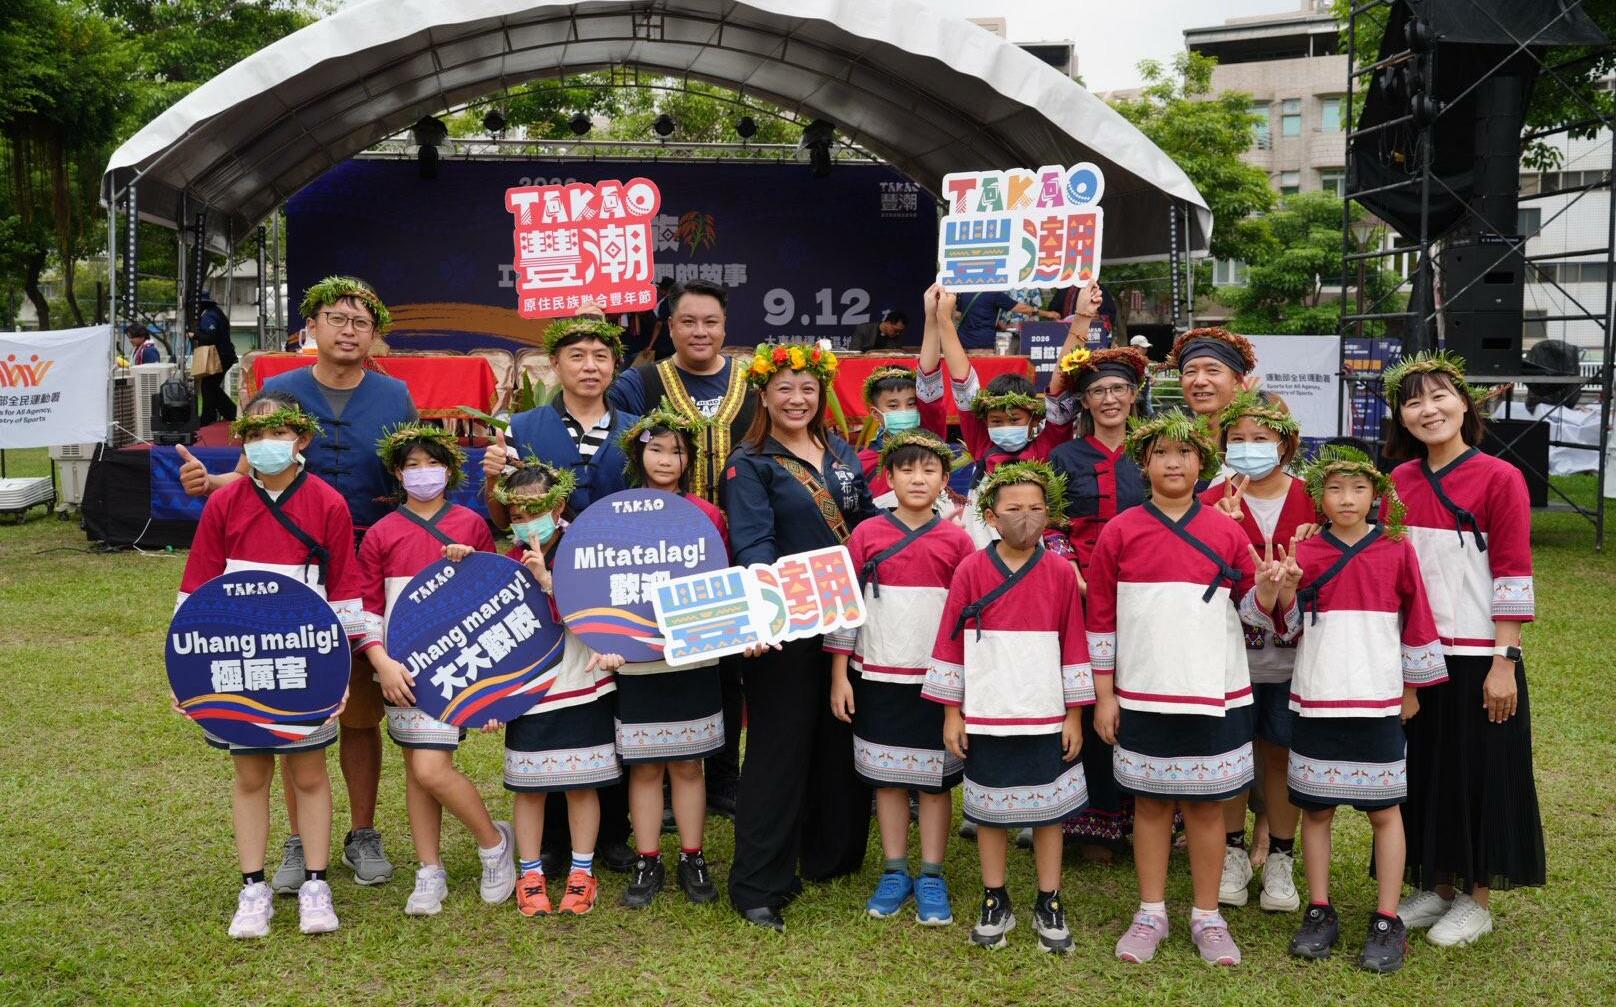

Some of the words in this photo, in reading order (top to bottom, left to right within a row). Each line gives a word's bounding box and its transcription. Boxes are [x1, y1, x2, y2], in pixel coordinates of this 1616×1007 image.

[511, 183, 655, 225] TAKAO
[948, 169, 1098, 213] TAKAO
[519, 224, 649, 289] 豐潮
[942, 213, 1096, 286] 豐潮
[763, 288, 871, 326] 9.12
[16, 408, 26, 416] All
[23, 416, 46, 424] Sports
[612, 498, 665, 514] TAKAO
[574, 537, 706, 570] Mitatalag!
[223, 581, 280, 597] TAKAO
[409, 566, 456, 604] TAKAO
[657, 551, 861, 659] 豐潮
[172, 630, 256, 659] Uhang
[261, 623, 340, 655] malig!
[400, 624, 469, 679] Uhang
[462, 570, 532, 633] maray!
[430, 602, 542, 701] 大大歡欣
[210, 655, 308, 694] 極厲害
